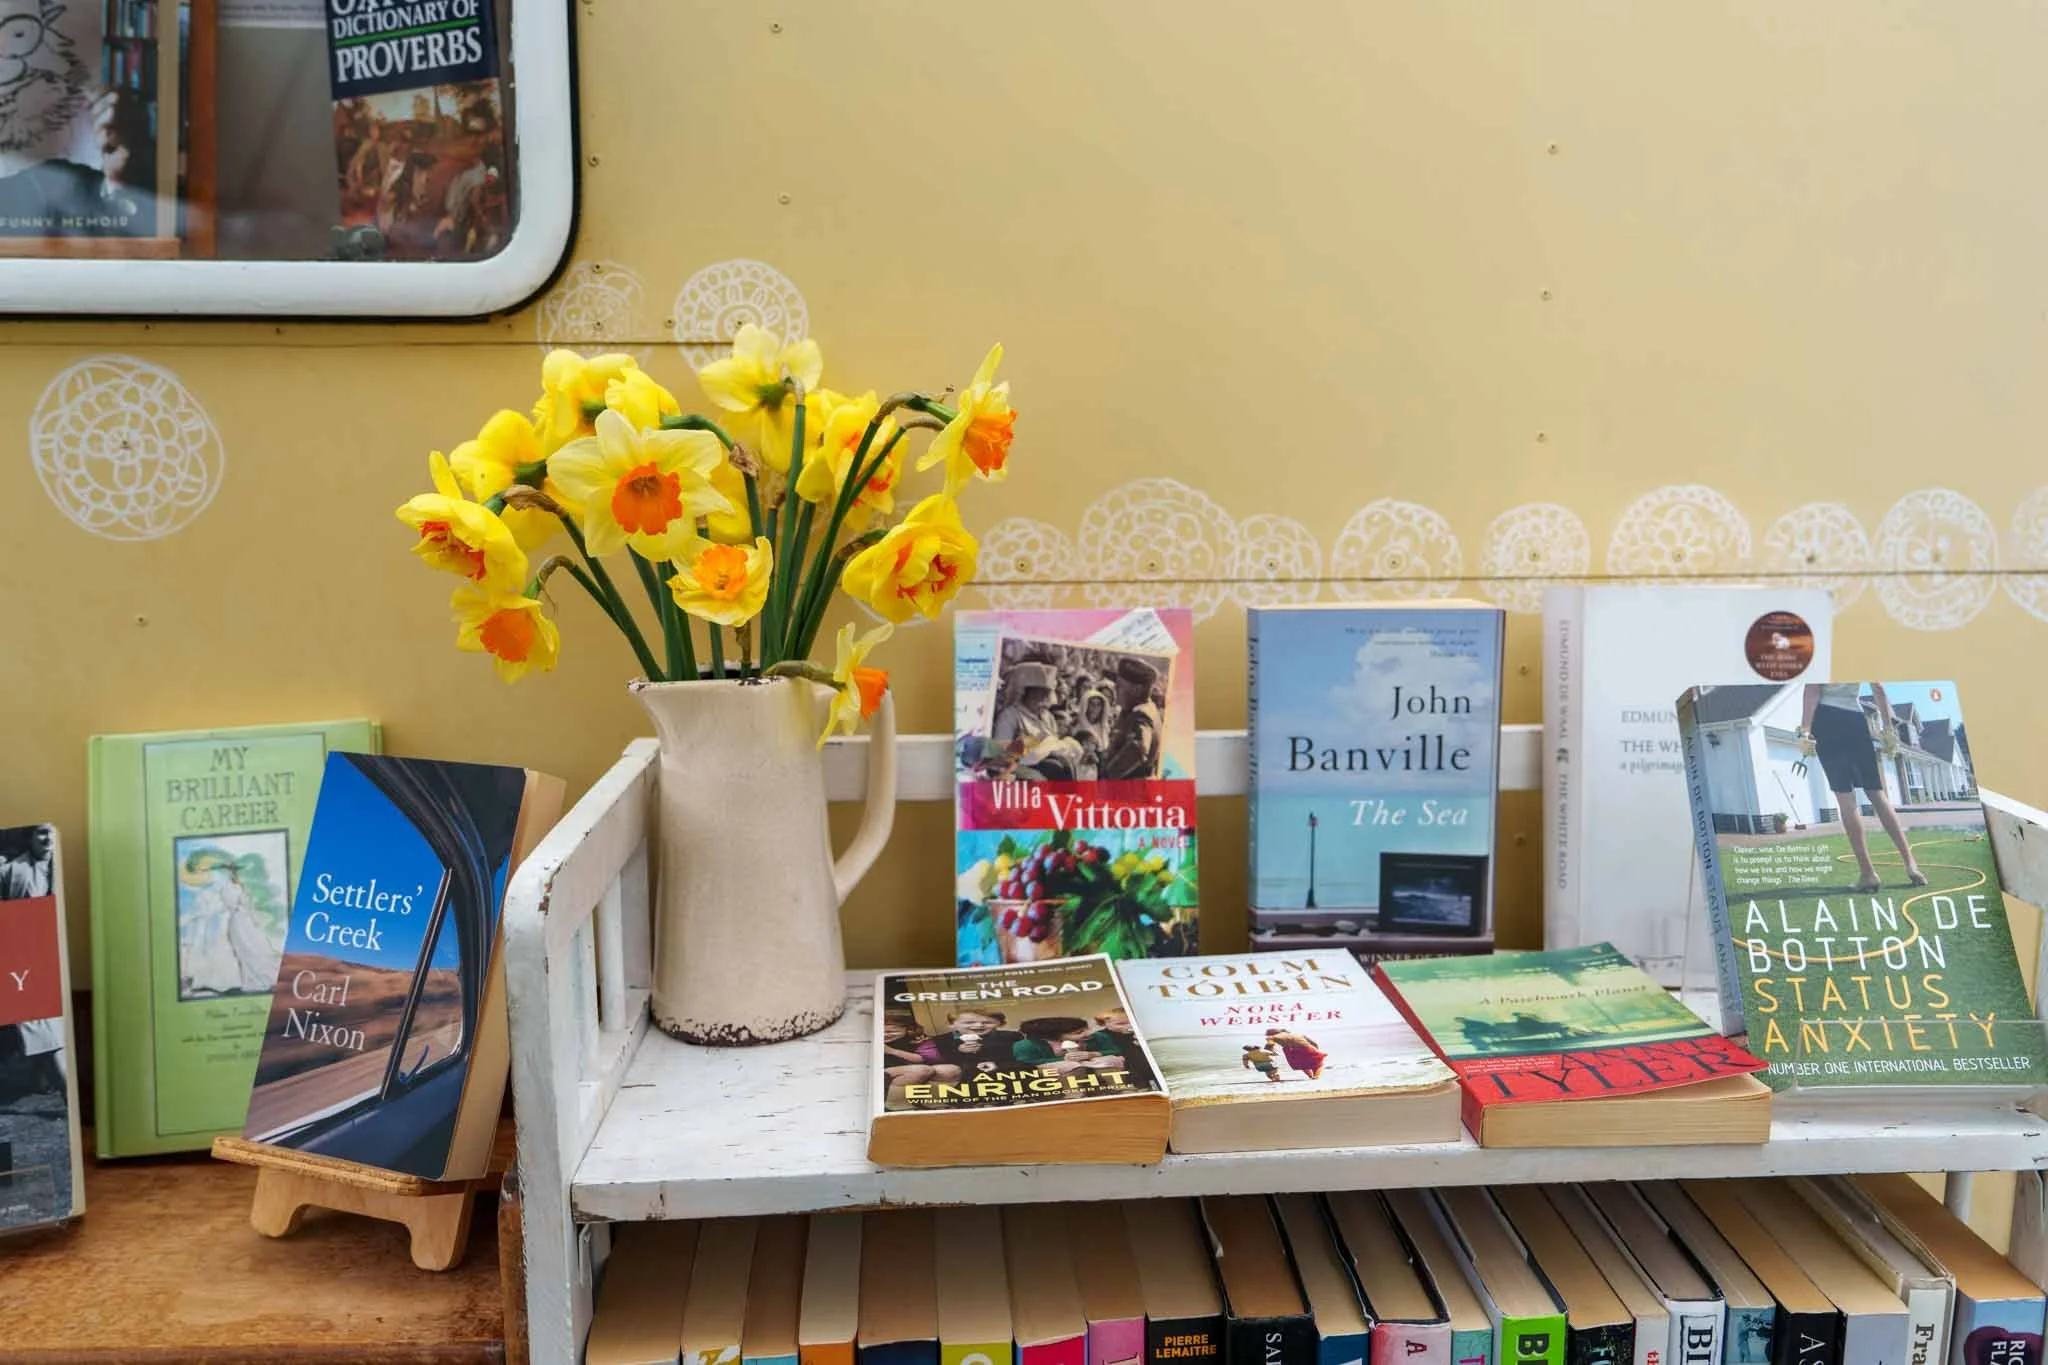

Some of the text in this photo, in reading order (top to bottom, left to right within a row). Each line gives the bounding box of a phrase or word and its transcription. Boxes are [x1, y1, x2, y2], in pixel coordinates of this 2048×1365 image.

[333, 1, 449, 39] DICTIONARY
[451, 0, 480, 18] OF
[336, 27, 482, 83] PROVERBS
[61, 216, 128, 228] MEMOIR
[1390, 685, 1471, 720] John
[1621, 711, 1677, 724] EDMUN
[209, 747, 249, 772] MY
[1288, 733, 1471, 772] Banville
[1619, 740, 1654, 752] THE
[167, 771, 295, 803] BRILLIANT
[992, 780, 1042, 810] Villa
[181, 800, 280, 831] CAREER
[1044, 795, 1189, 831] Vittoria
[1350, 799, 1469, 826] The Sea
[1745, 895, 1992, 934] ALAIN DE
[305, 912, 384, 951] Creek
[1747, 935, 1946, 973] BOTTON
[1161, 959, 1319, 979] COLM
[292, 970, 351, 1007] Carl
[893, 989, 1002, 1002] GREEN
[1012, 980, 1103, 998] ROAD
[976, 979, 1018, 989] THE
[1147, 974, 1353, 998] TÓIBÍN
[1753, 974, 1951, 1013] STATUS
[1200, 1010, 1342, 1027] WEBSTER
[1224, 1002, 1304, 1015] NORA
[282, 1007, 366, 1051] Nixon
[1764, 1012, 1996, 1054] ANXIETY
[1561, 1036, 1726, 1072] ANNE
[1768, 1057, 2031, 1075] NUMBER ONE INTERNATIONAL BESTSELLER
[904, 1070, 1130, 1099] ENRIGHT
[973, 1068, 1060, 1082] ANNE
[1467, 1051, 1757, 1098] TYLER
[1155, 1344, 1217, 1359] LEMAITRE
[1165, 1334, 1209, 1346] PIERRE
[1990, 1341, 2007, 1365] FL
